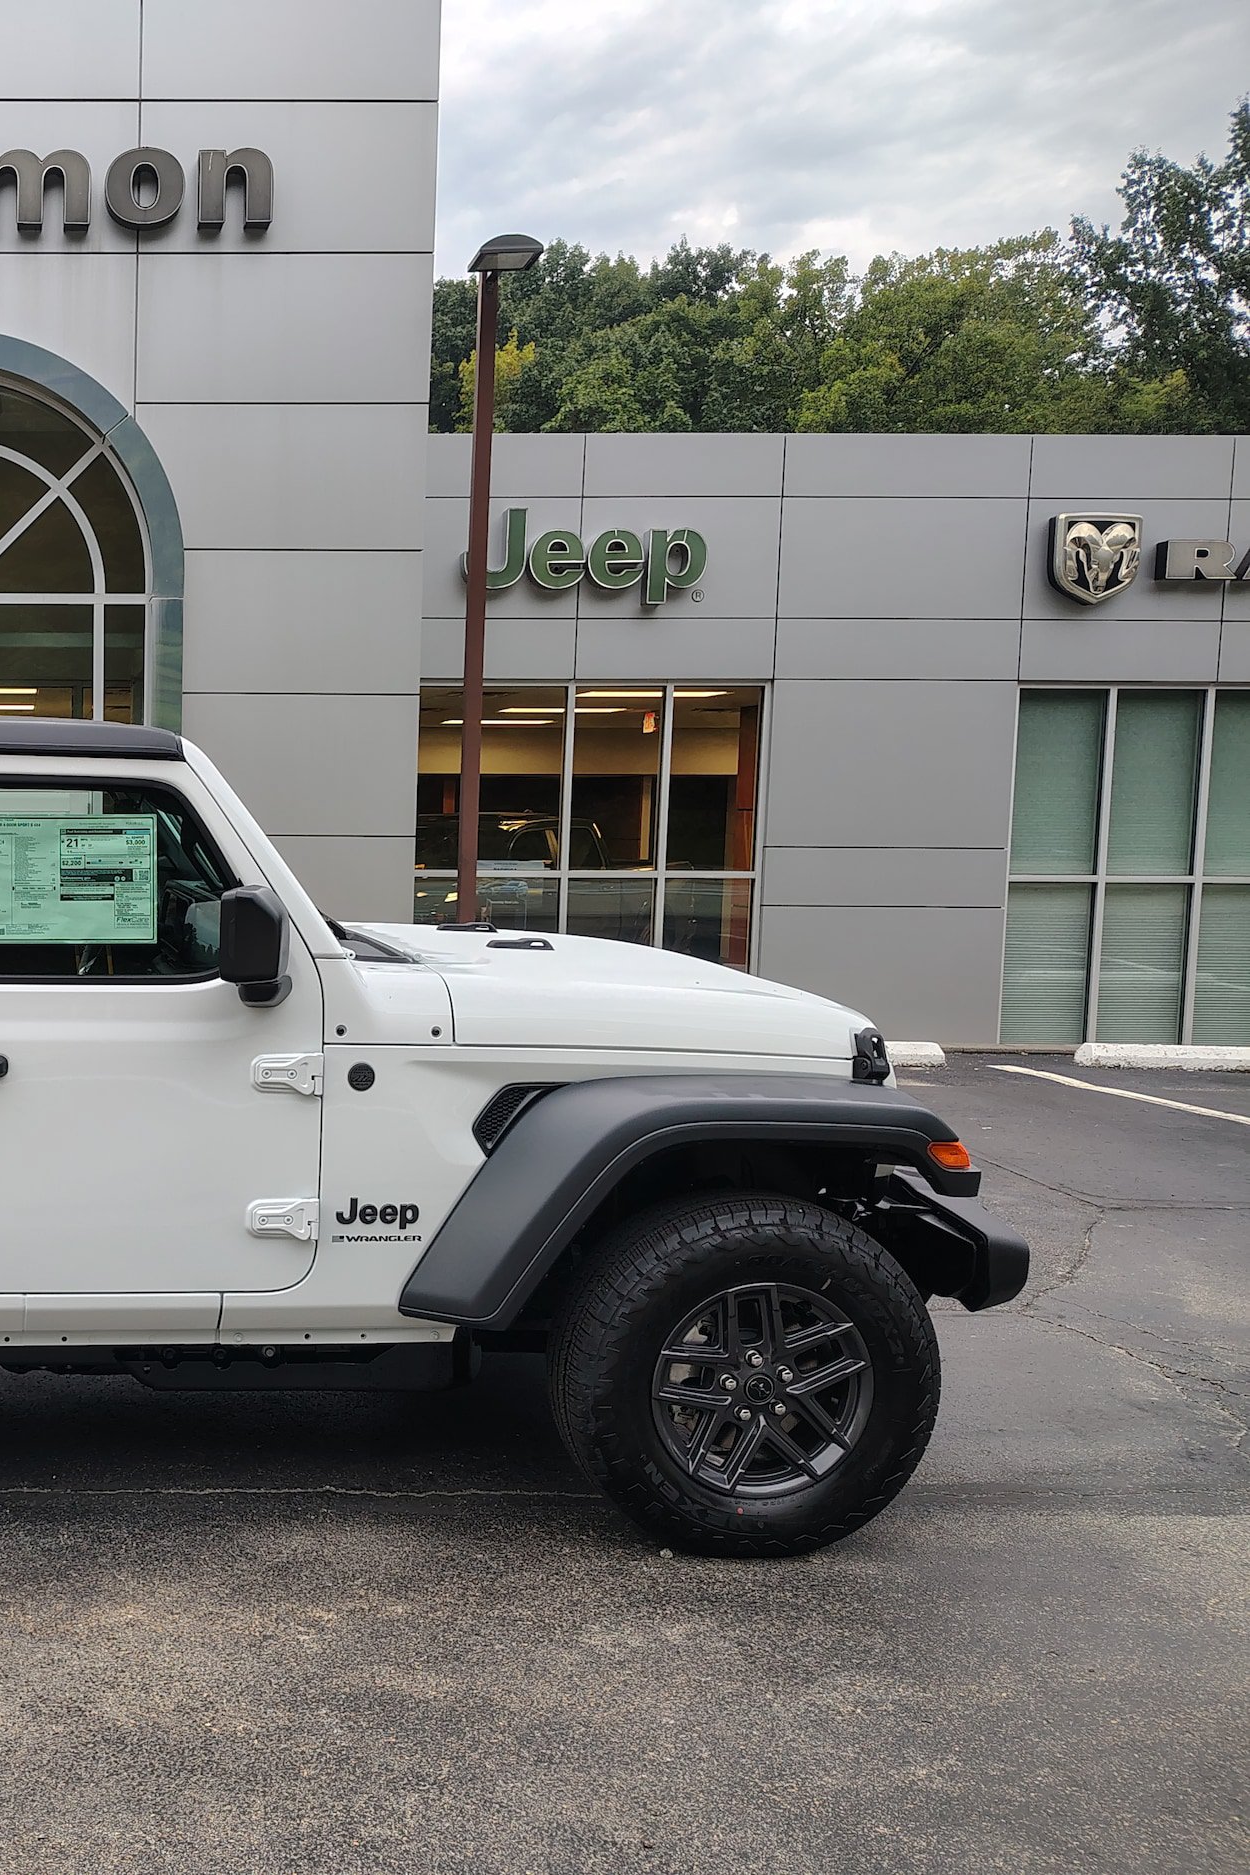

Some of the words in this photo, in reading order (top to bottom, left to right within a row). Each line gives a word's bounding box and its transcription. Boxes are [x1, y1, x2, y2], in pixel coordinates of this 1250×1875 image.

[461, 507, 708, 606] Jeep
[1154, 538, 1250, 580] R
[66, 838, 78, 847] 21
[336, 1197, 419, 1230] Jeep
